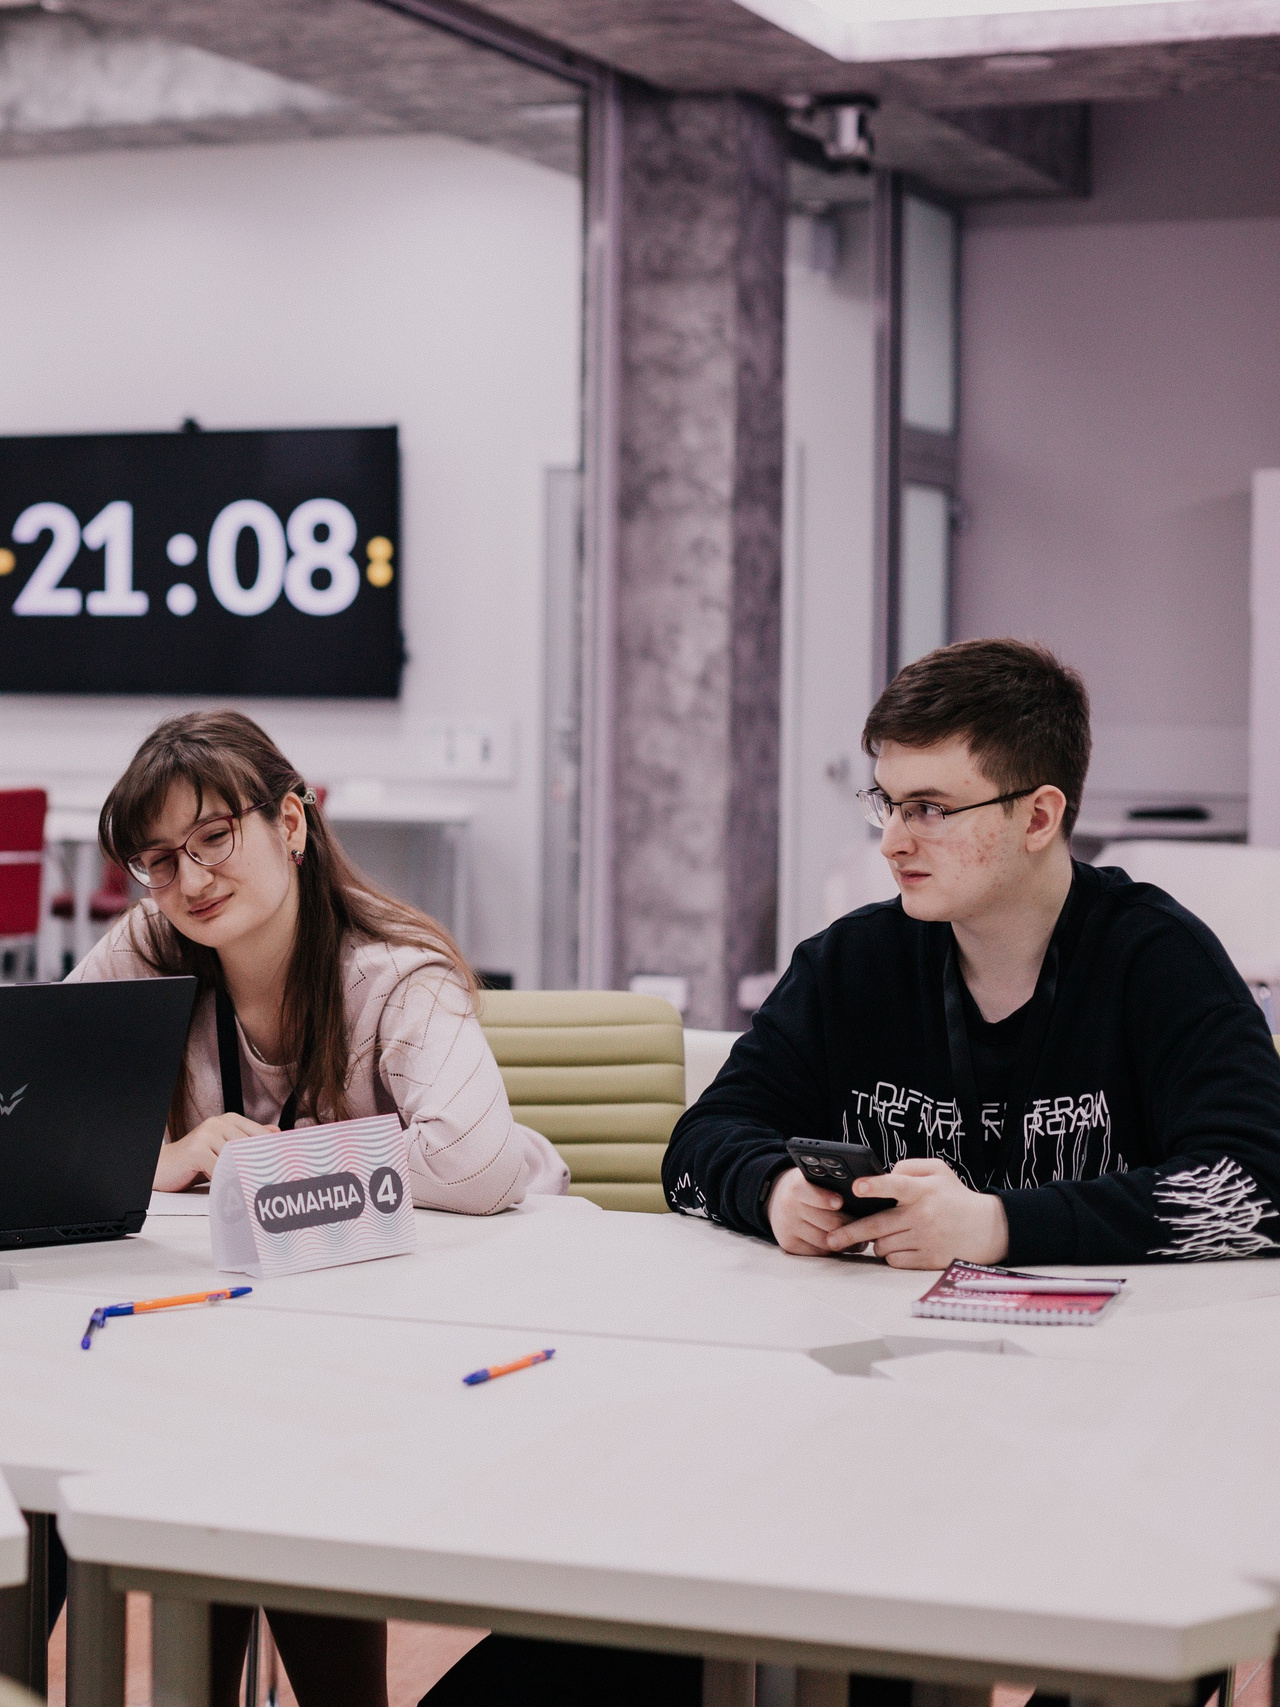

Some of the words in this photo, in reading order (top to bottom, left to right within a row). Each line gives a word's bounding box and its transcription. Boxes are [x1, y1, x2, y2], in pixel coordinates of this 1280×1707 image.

[11, 497, 361, 616] 21:08
[257, 1184, 362, 1221] КОМАНДА
[376, 1174, 398, 1206] 4
